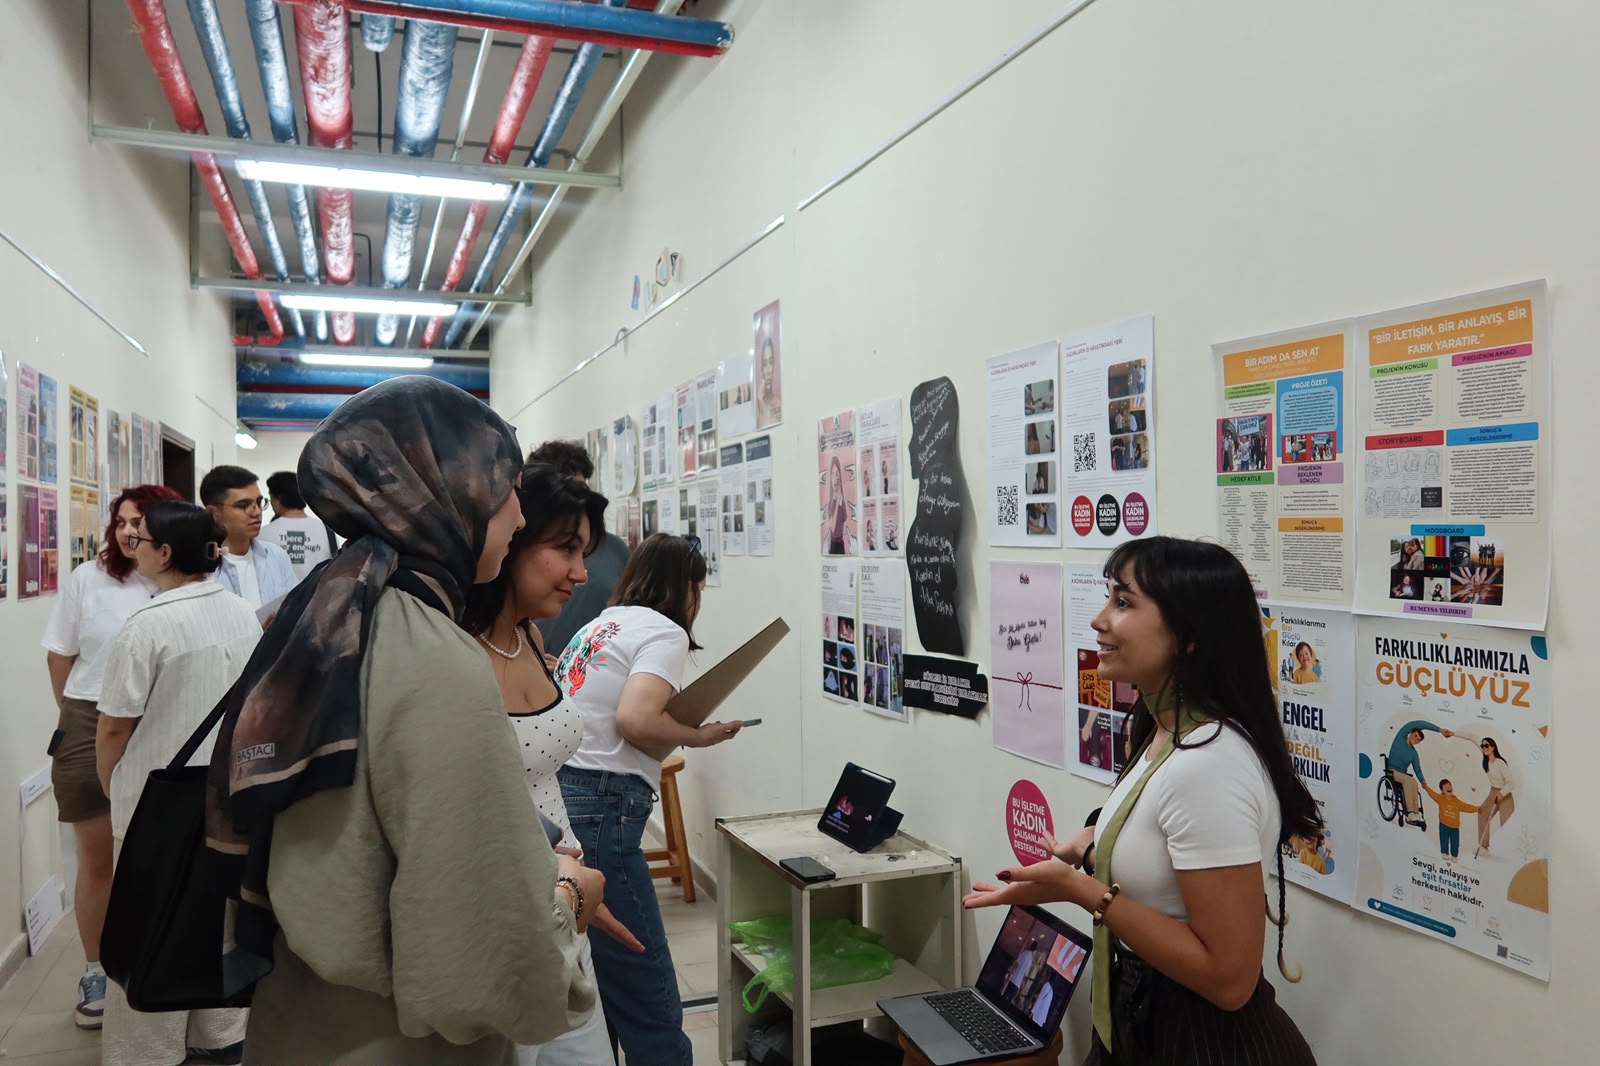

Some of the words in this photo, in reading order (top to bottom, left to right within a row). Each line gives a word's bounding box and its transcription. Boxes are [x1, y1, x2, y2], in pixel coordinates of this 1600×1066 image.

[1438, 320, 1455, 333] BİR
[1508, 306, 1527, 321] BİR
[1257, 354, 1277, 365] ADIM
[1280, 353, 1290, 362] DA
[1292, 348, 1308, 360] SEN
[1308, 346, 1320, 356] AT
[1407, 342, 1433, 356] FARK
[1376, 365, 1404, 374] PROJENİN
[1404, 362, 1429, 371] KONUSU
[1292, 380, 1310, 390] PROJE
[1378, 436, 1424, 445] STORYBOARD
[1098, 508, 1116, 517] KADIN
[1125, 507, 1144, 516] KADIN
[280, 534, 303, 542] There
[292, 544, 321, 552] enough
[1282, 632, 1300, 640] Güçlü
[1375, 636, 1530, 675] FARKLILIKLARIMIZLA
[1376, 659, 1530, 708] GÜÇLÜYÜZ
[1282, 702, 1326, 732] ENGEL
[1290, 756, 1330, 784] RKLILIK
[1012, 798, 1020, 808] BU
[1021, 798, 1046, 816] İŞLETME
[1012, 808, 1047, 833] KADIN
[1014, 840, 1048, 858] DESTEKLİYOR
[1412, 857, 1437, 873] Sevgi,
[1439, 866, 1468, 884] anlayış
[1469, 876, 1480, 886] ve
[1422, 872, 1437, 883] eşit
[1438, 875, 1472, 893] fırsatlar
[1412, 877, 1446, 895] herkesin
[1448, 888, 1484, 908] hakkıdır.
